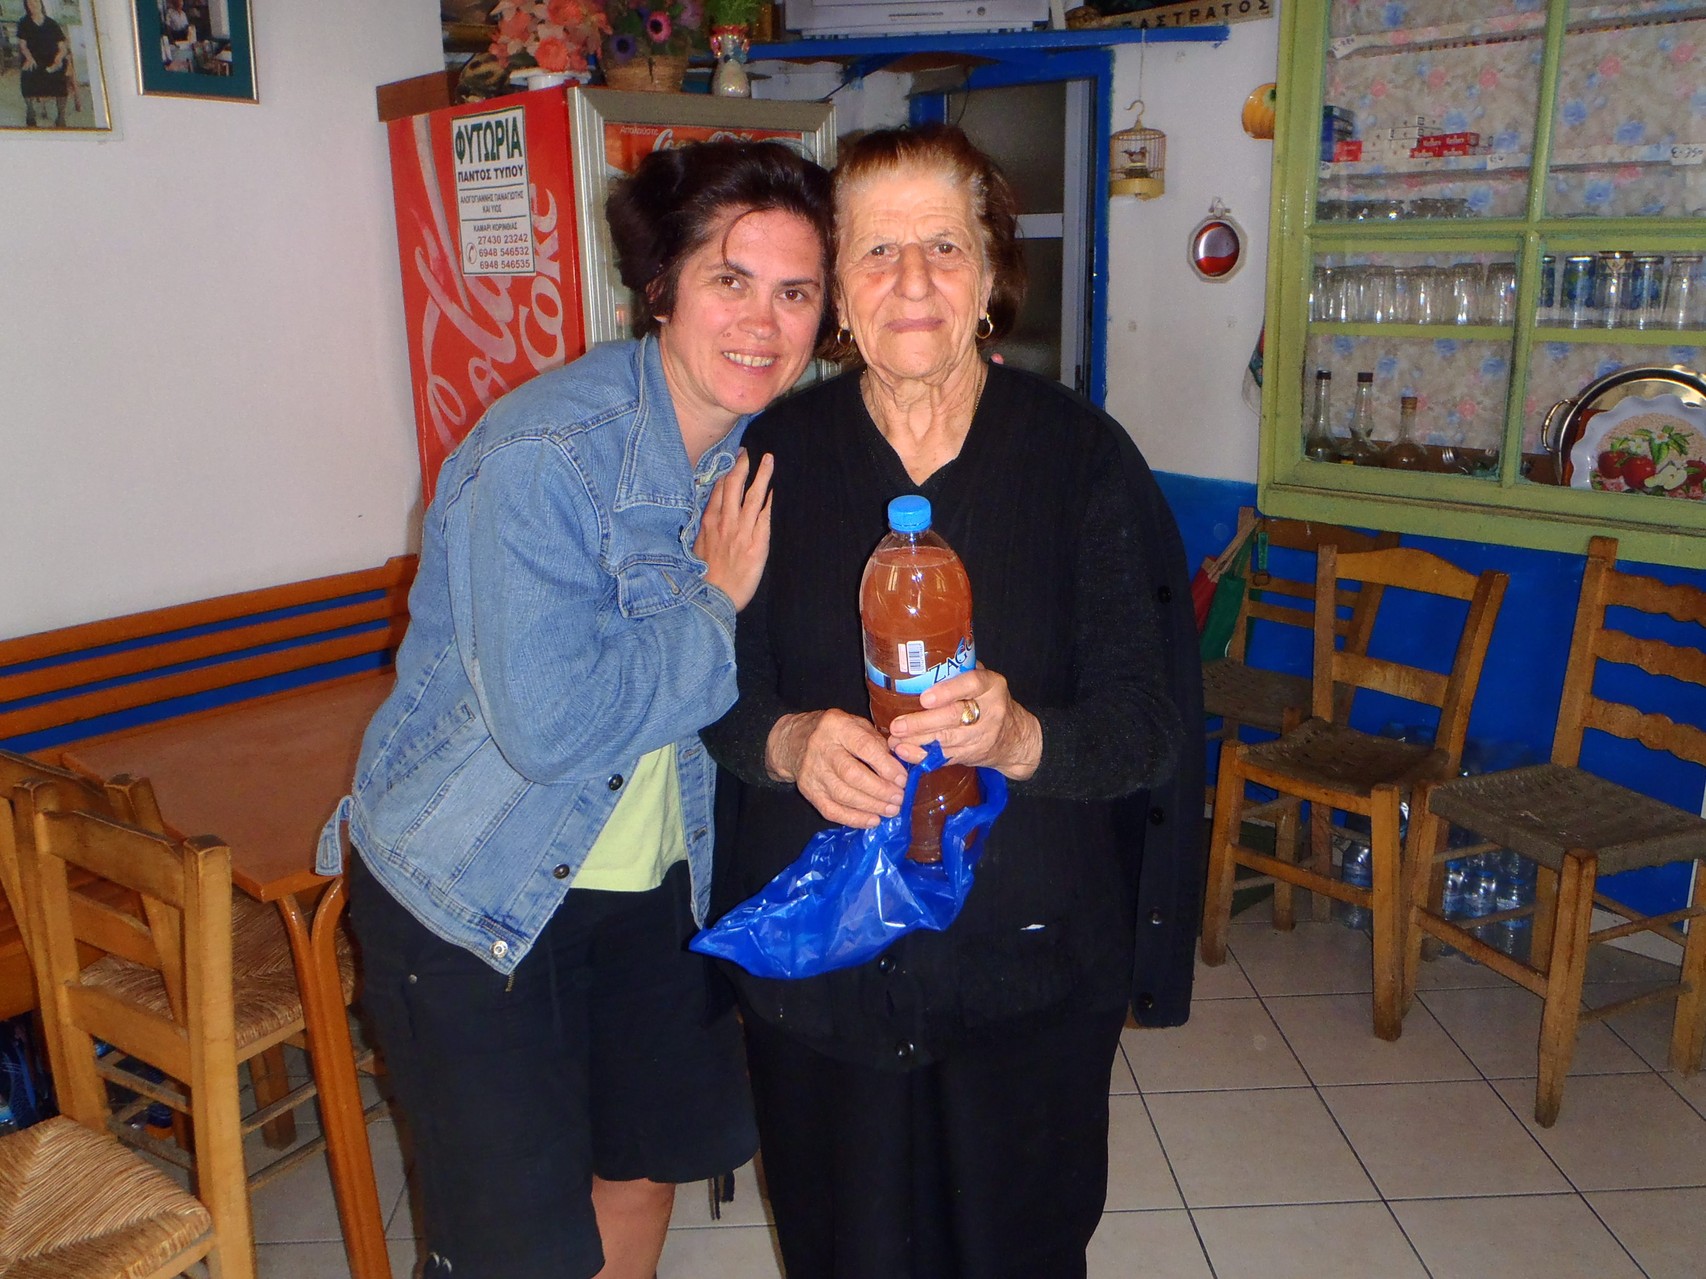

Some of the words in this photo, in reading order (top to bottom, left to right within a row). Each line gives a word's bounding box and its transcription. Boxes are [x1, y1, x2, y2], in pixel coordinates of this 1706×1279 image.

[455, 117, 523, 164] ΦΥΤΩΡΙΑ
[458, 168, 492, 183] ΠΑΝΤΟΣ
[494, 164, 524, 180] ΤΥΠΟΥ
[473, 223, 491, 232] ΚΑΜΑΡΙ
[477, 235, 502, 245] 27430
[503, 233, 528, 244] 23242
[479, 248, 498, 257] 6948
[500, 246, 530, 257] 546532
[479, 261, 499, 270] 6948
[501, 259, 531, 269] 546535
